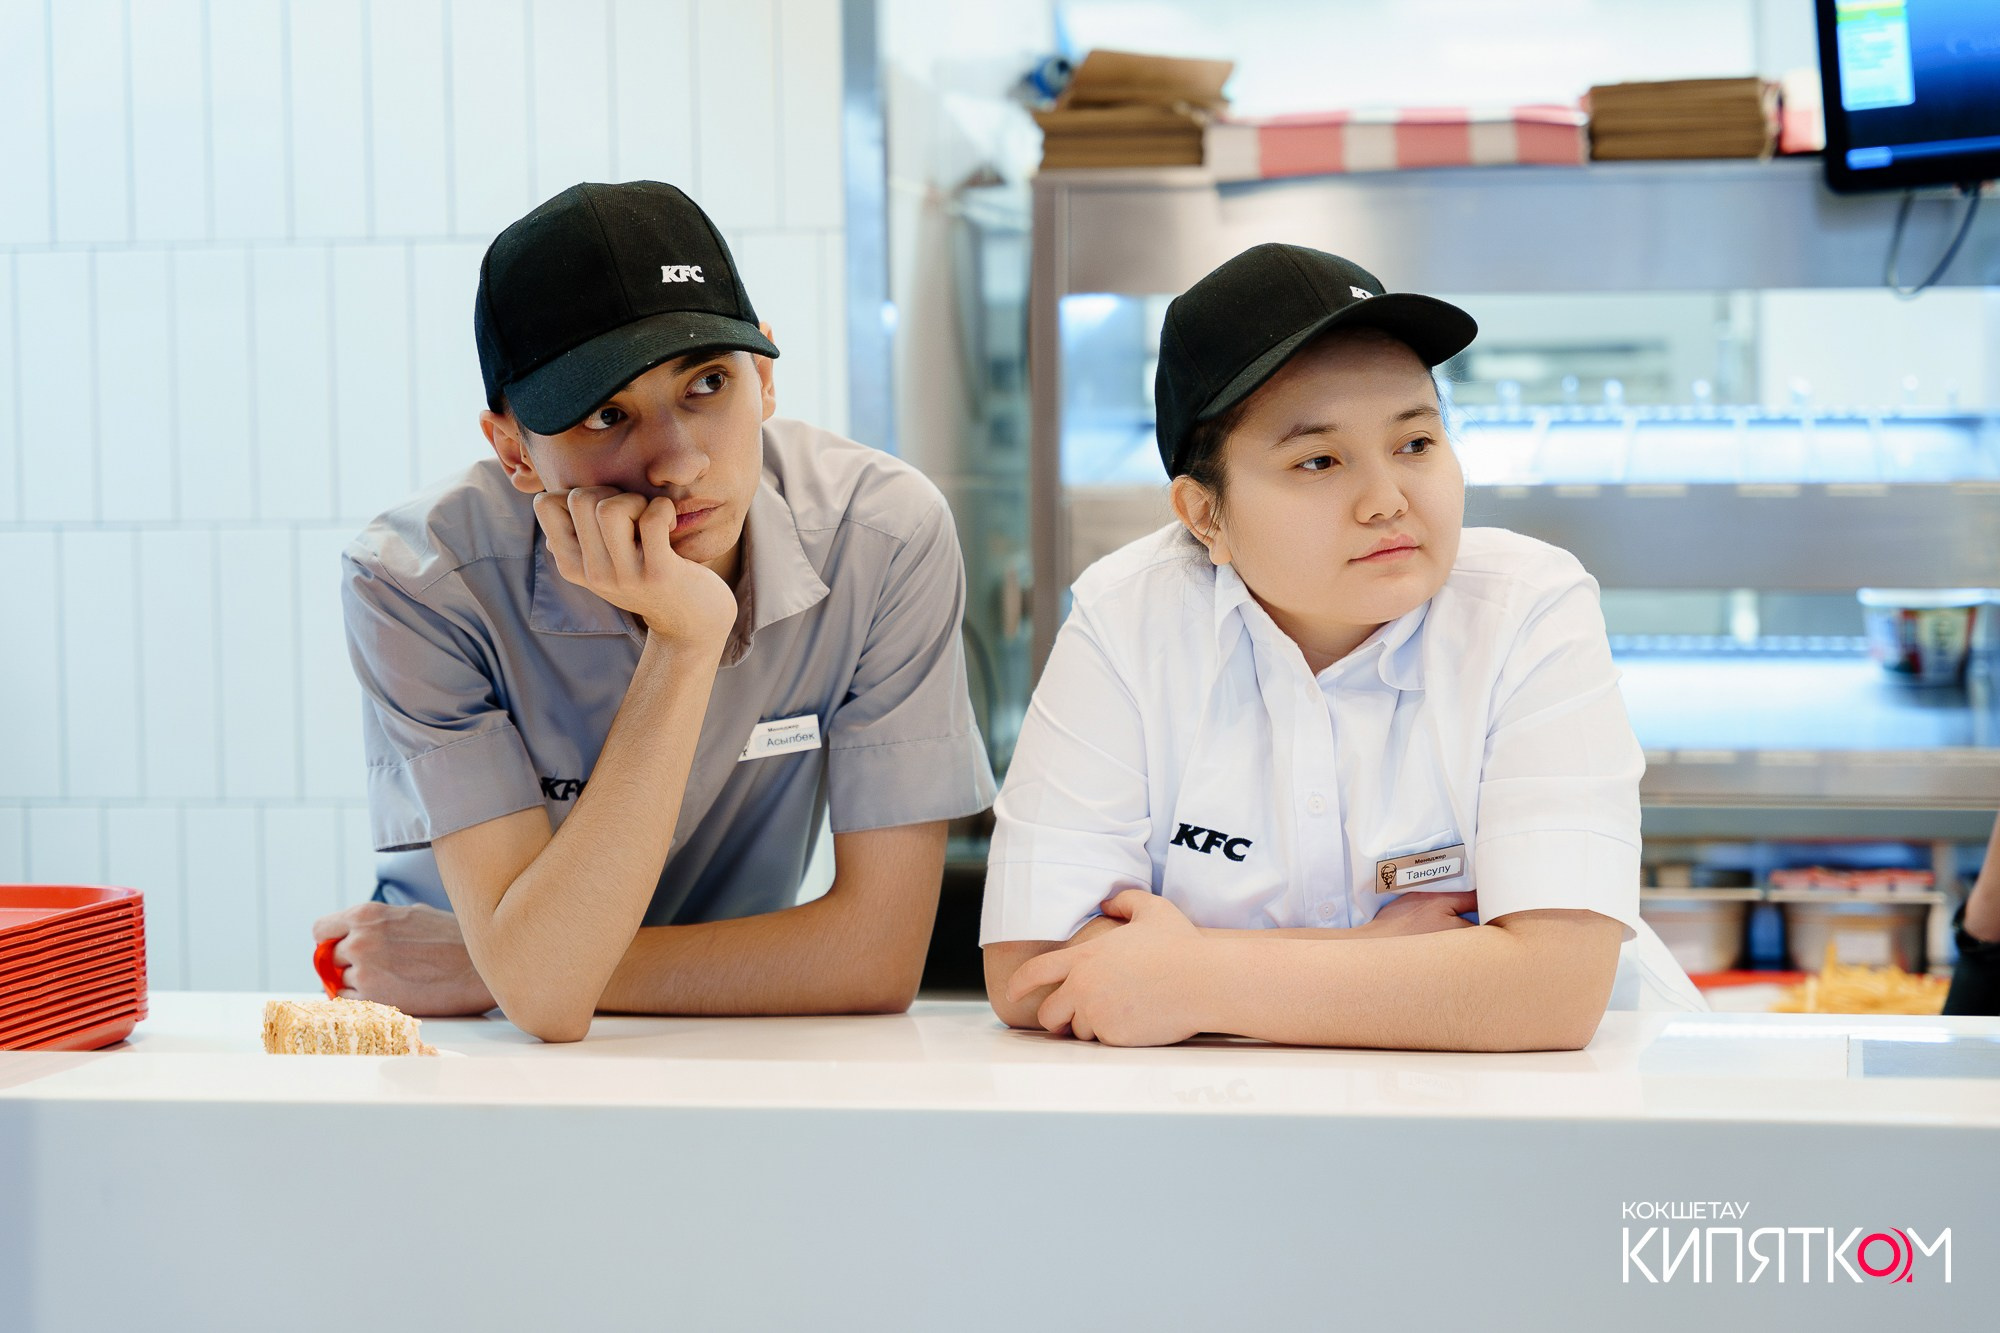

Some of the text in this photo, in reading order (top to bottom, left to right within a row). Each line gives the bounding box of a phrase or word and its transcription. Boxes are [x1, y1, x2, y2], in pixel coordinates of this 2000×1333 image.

[661, 265, 705, 283] KFC
[1170, 822, 1253, 862] KFC
[1406, 864, 1451, 880] Тансулу
